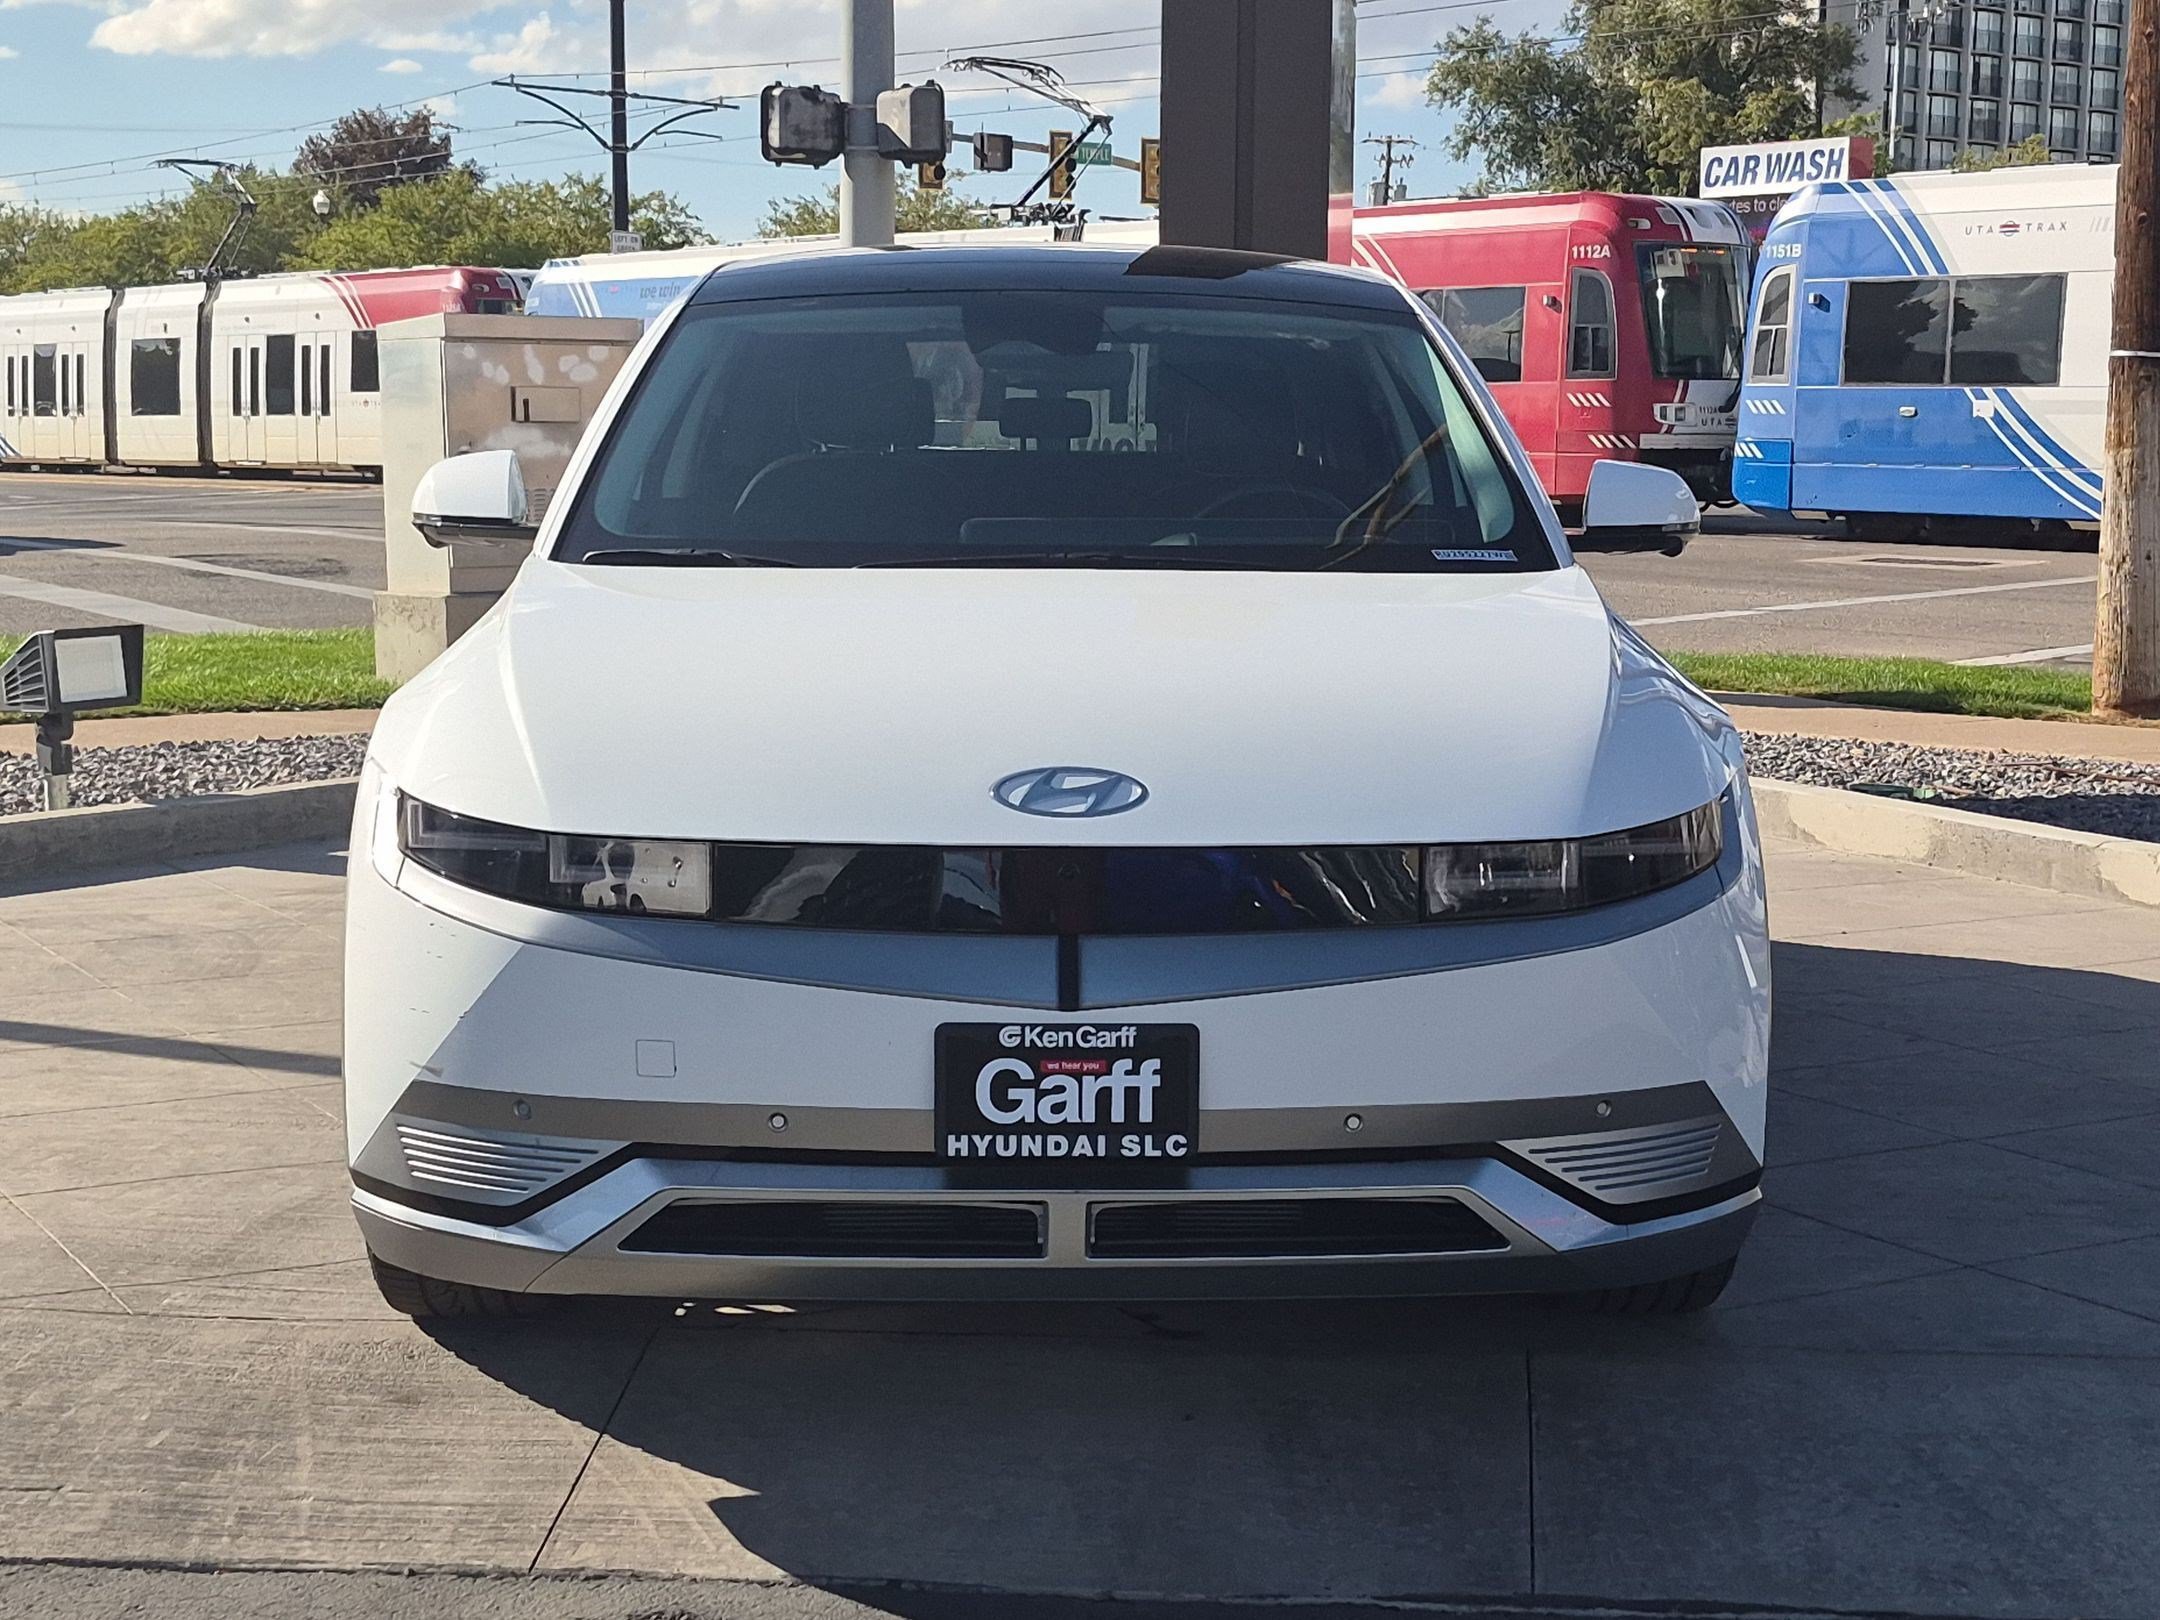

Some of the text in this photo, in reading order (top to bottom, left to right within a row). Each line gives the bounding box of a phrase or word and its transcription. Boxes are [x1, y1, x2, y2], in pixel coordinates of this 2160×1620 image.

[1704, 147, 1846, 188] CAR WASH
[1753, 198, 1767, 213] to
[1965, 221, 2068, 236] UTA TRAX
[1571, 245, 1611, 260] 1112A
[1765, 243, 1802, 258] 1151B
[1702, 418, 1722, 426] UTA
[1024, 1025, 1137, 1048] Ken Garff
[1062, 1061, 1081, 1070] hear
[1082, 1062, 1100, 1072] you
[976, 1057, 1161, 1125] Garff
[947, 1134, 1188, 1157] HYUNDAI SLC
